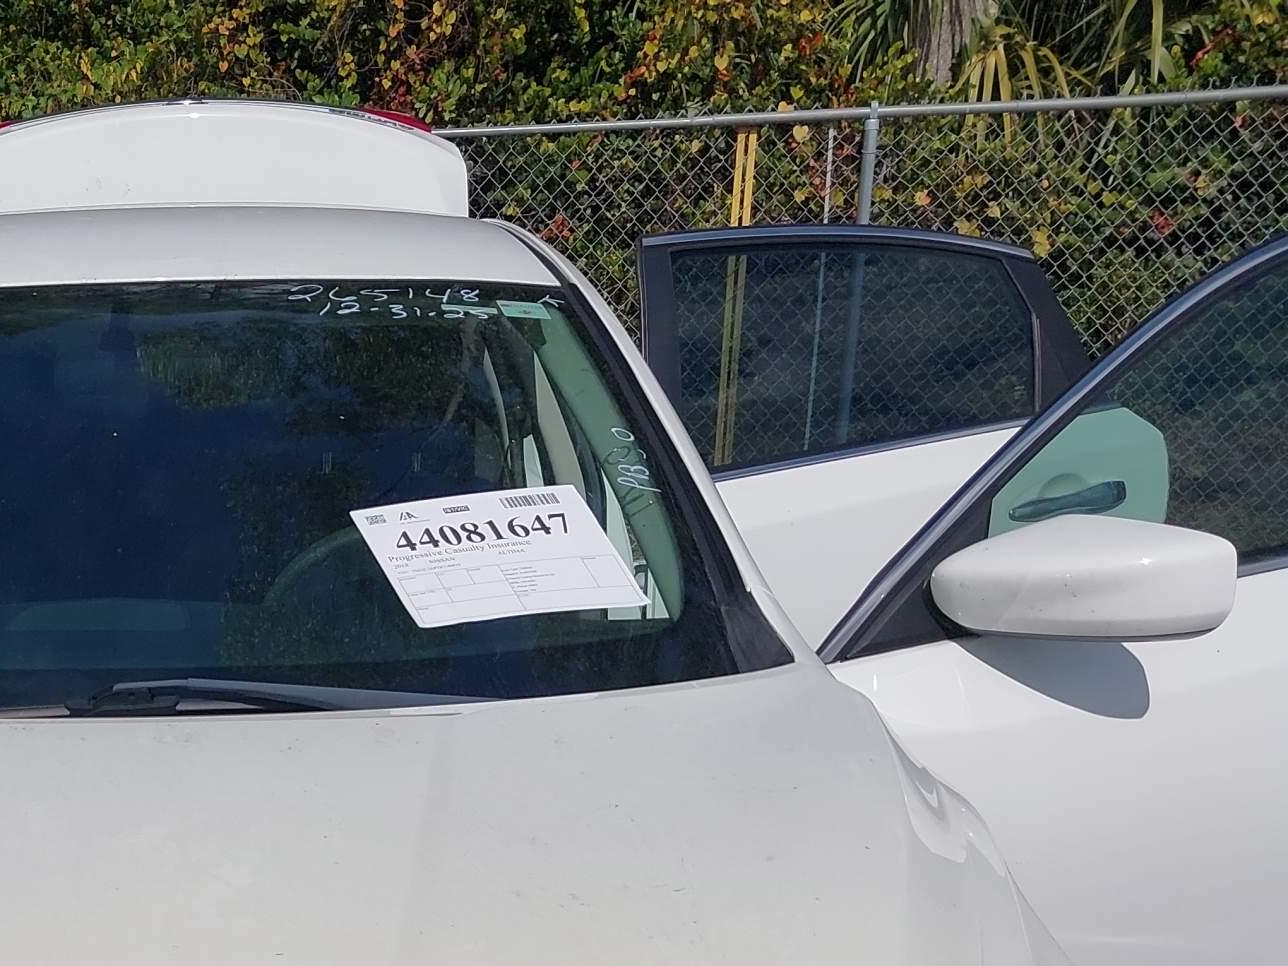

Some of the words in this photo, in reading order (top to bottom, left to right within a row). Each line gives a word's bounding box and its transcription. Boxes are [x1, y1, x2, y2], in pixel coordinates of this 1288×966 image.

[396, 512, 569, 552] 44081647
[387, 549, 443, 563] Progressive
[444, 544, 485, 555] Casualty
[486, 540, 532, 550] Insurance
